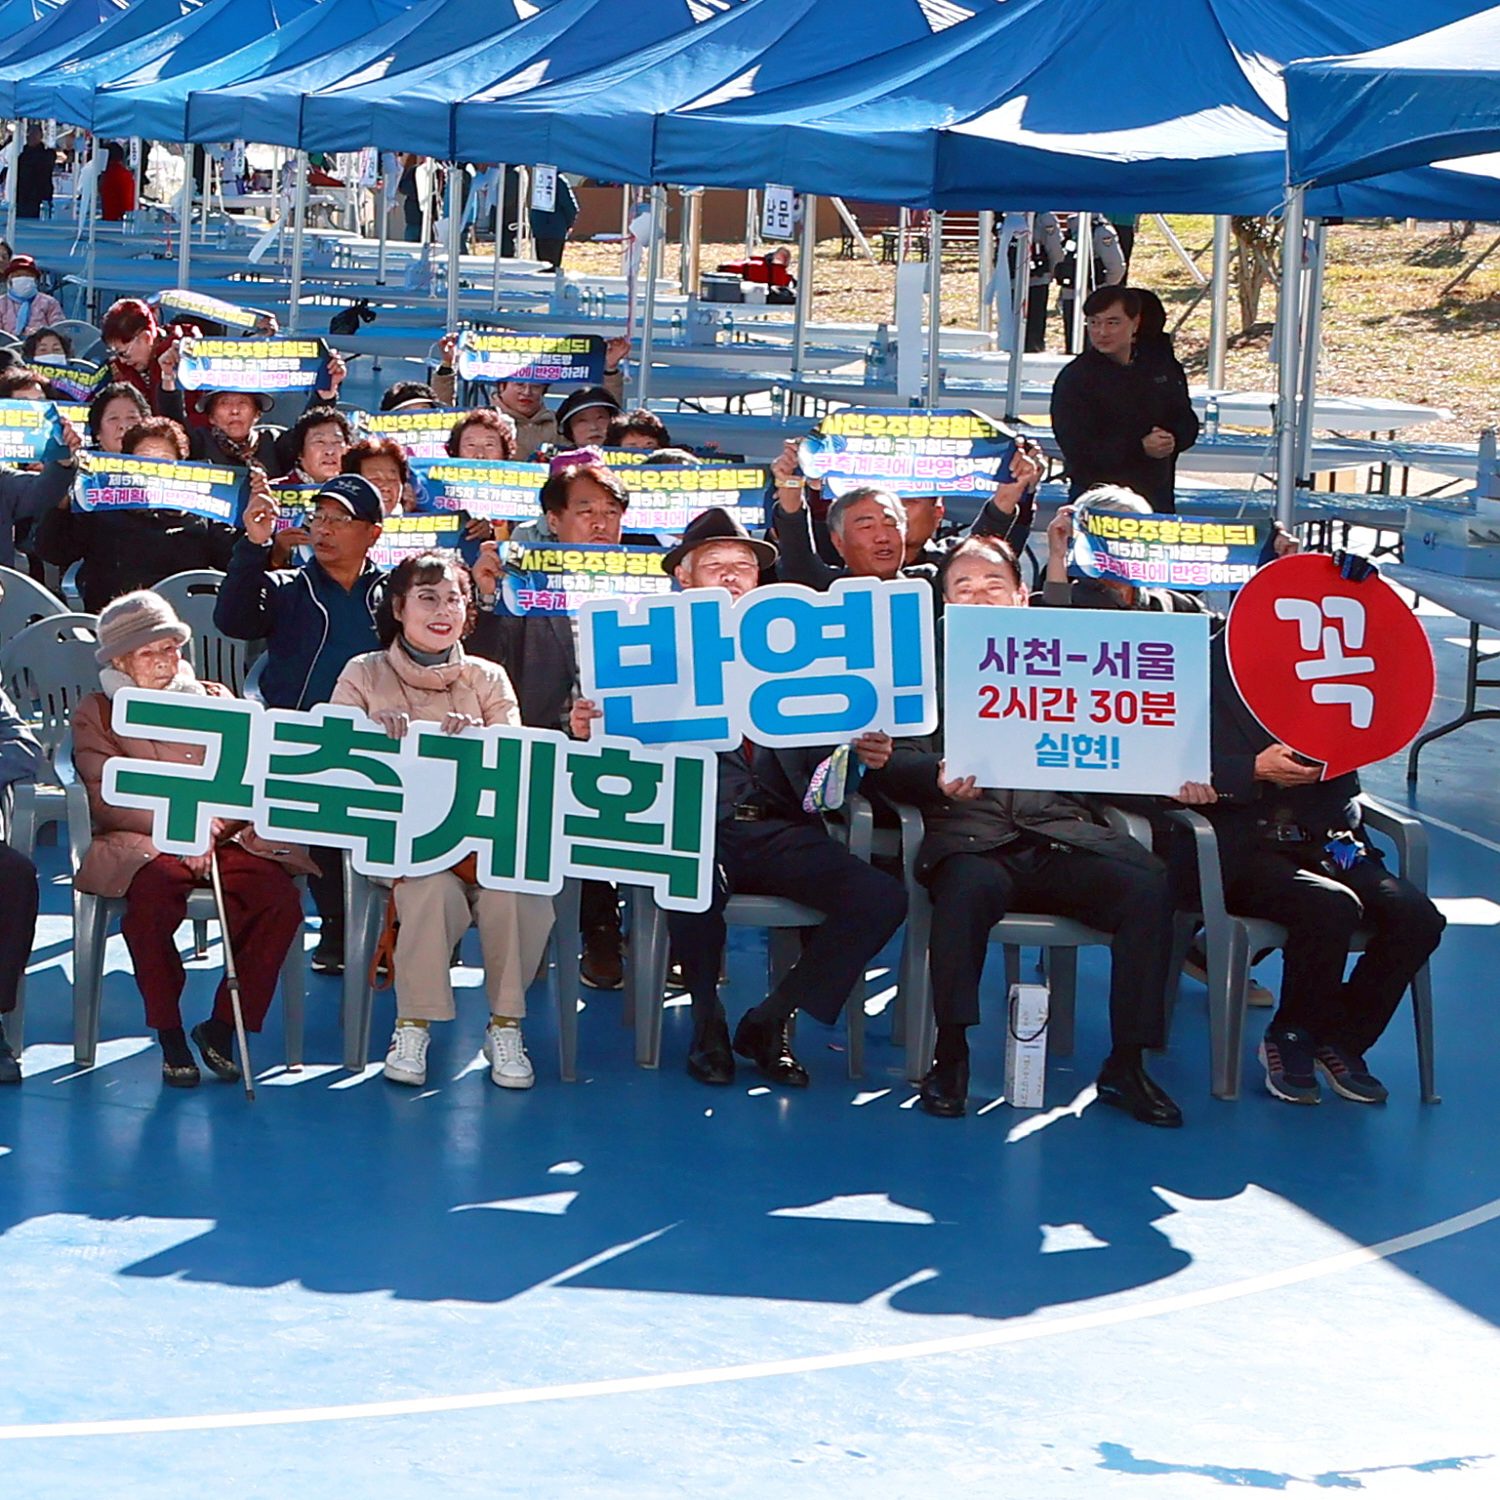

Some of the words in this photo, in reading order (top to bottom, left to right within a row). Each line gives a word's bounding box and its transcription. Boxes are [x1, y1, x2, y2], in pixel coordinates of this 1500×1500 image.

[822, 415, 997, 437] 사천우주항공철도!
[846, 437, 891, 454] 제5차
[894, 440, 973, 455] 국가철도망
[427, 466, 549, 488] 사천우주항공철도
[621, 470, 764, 490] 천우주항공철도!
[814, 455, 911, 476] 구축계획에
[915, 456, 1001, 478] 반영하라!
[594, 591, 925, 742] 반영!
[978, 637, 1175, 681] 사천-서울
[1274, 598, 1374, 729] 꼭
[978, 685, 1077, 723] 2시간
[1089, 690, 1176, 726] 30분
[1035, 733, 1120, 769] 실현!
[116, 699, 704, 899] 구축계획
